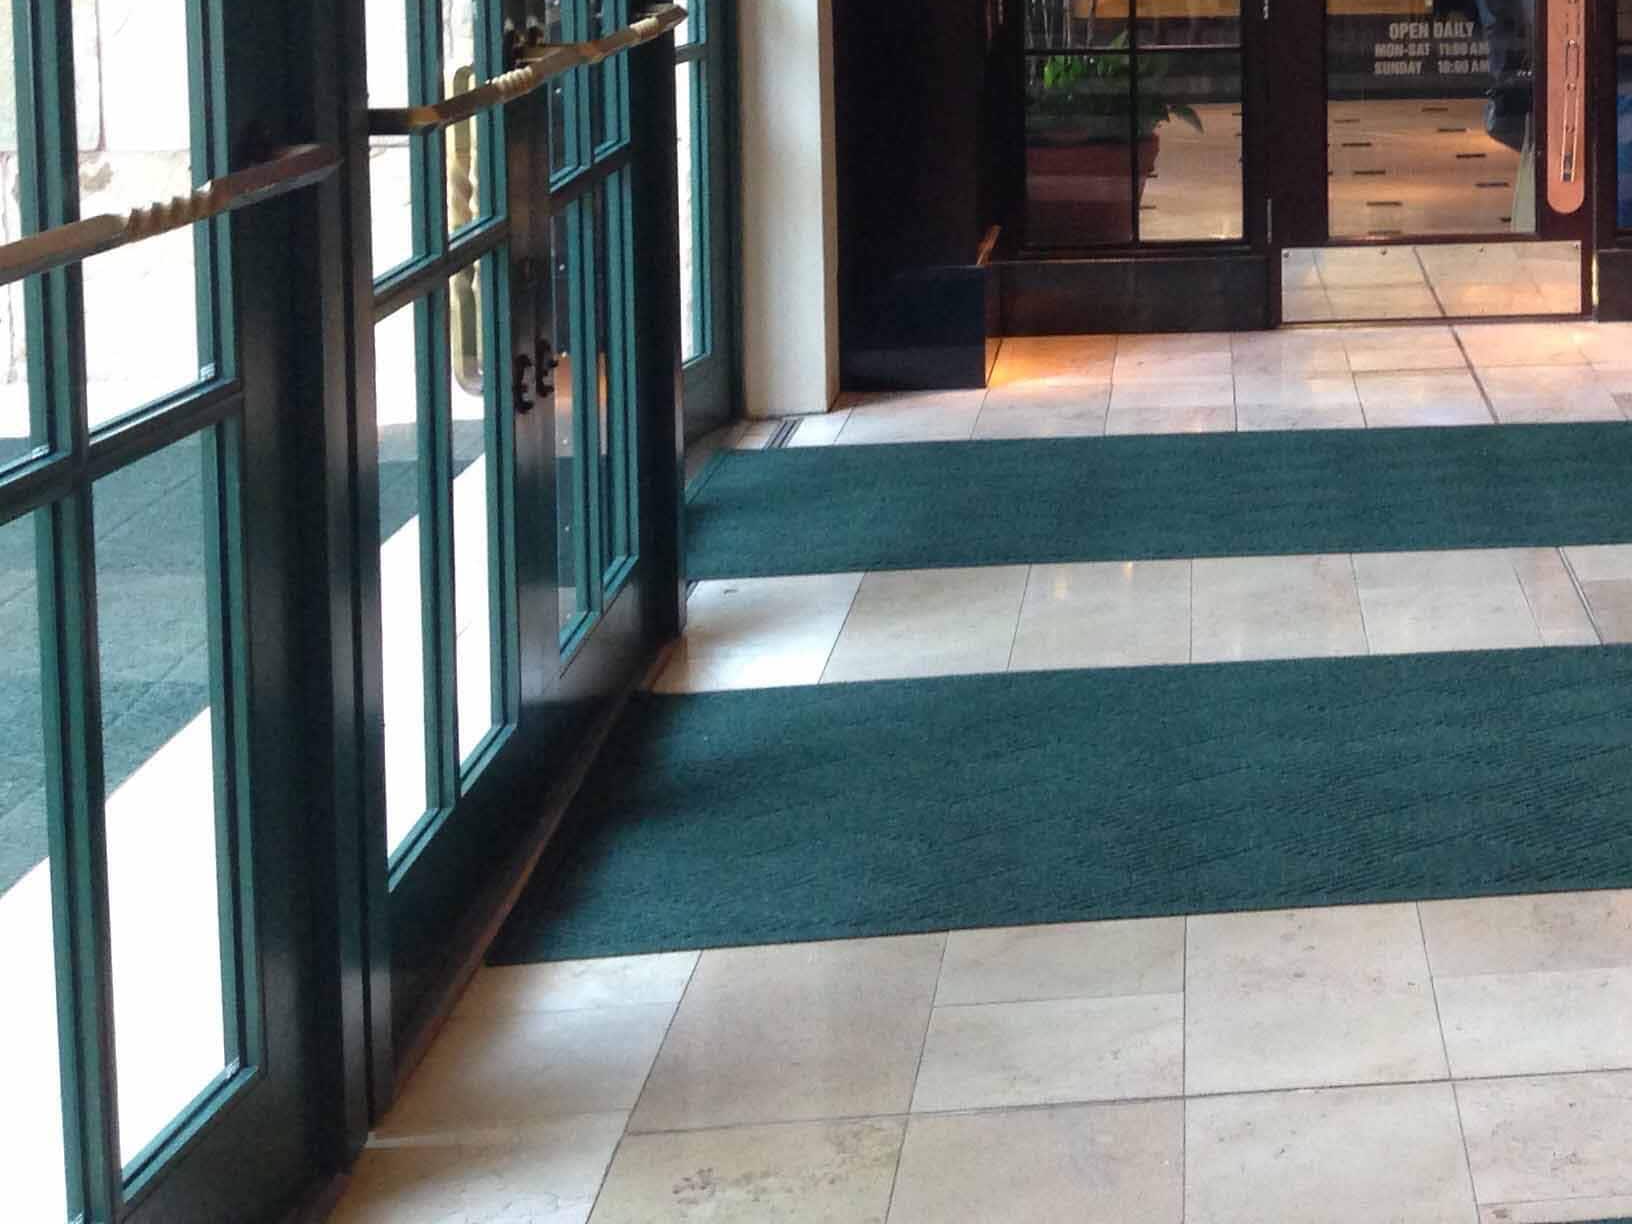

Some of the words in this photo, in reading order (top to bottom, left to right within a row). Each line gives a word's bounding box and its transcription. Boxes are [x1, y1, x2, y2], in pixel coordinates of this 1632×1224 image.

[1389, 22, 1430, 39] OPEN
[1433, 21, 1475, 39] DAILY
[1374, 60, 1423, 75] SUNDAY
